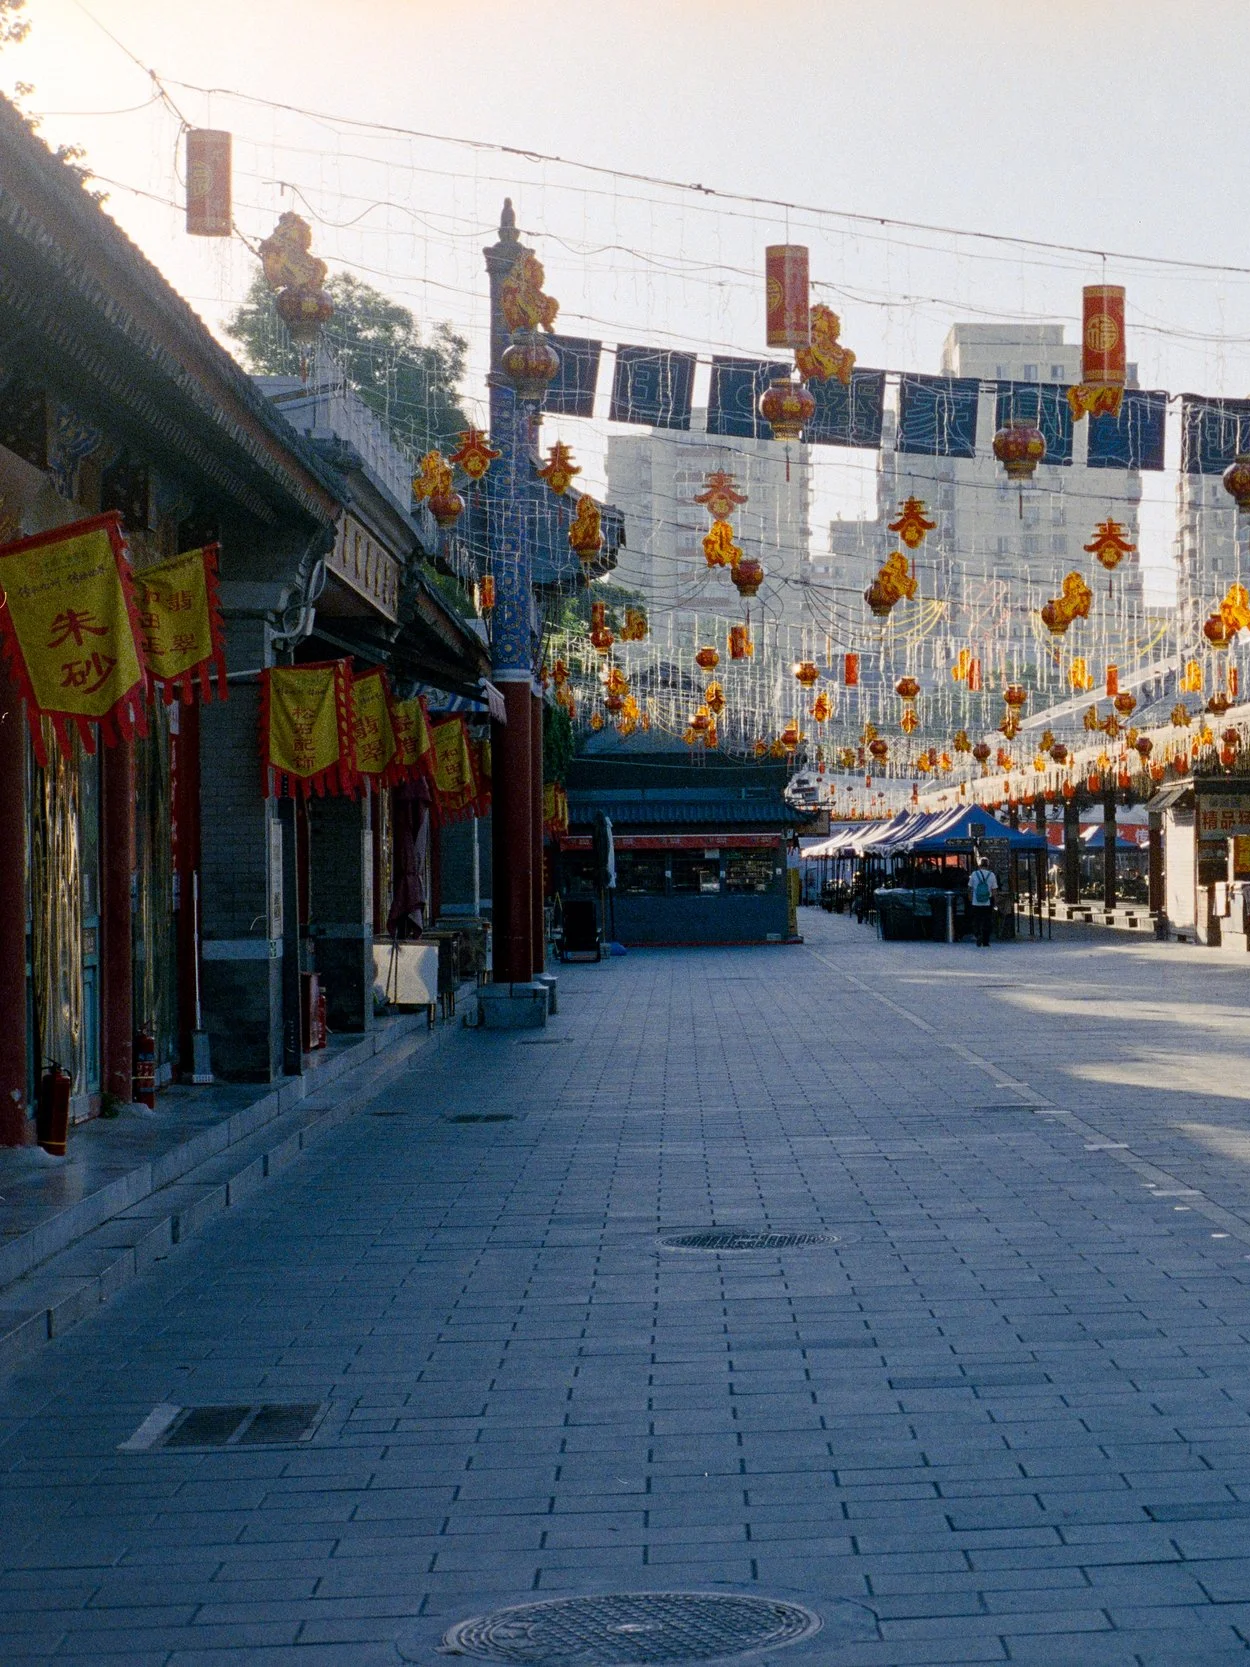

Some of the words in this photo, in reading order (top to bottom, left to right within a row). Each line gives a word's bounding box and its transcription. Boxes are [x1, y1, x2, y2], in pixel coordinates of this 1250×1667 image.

[1088, 315, 1119, 352] 福
[168, 589, 199, 655] 翡翠
[47, 608, 118, 695] 朱砂
[354, 714, 386, 763] 翡翠
